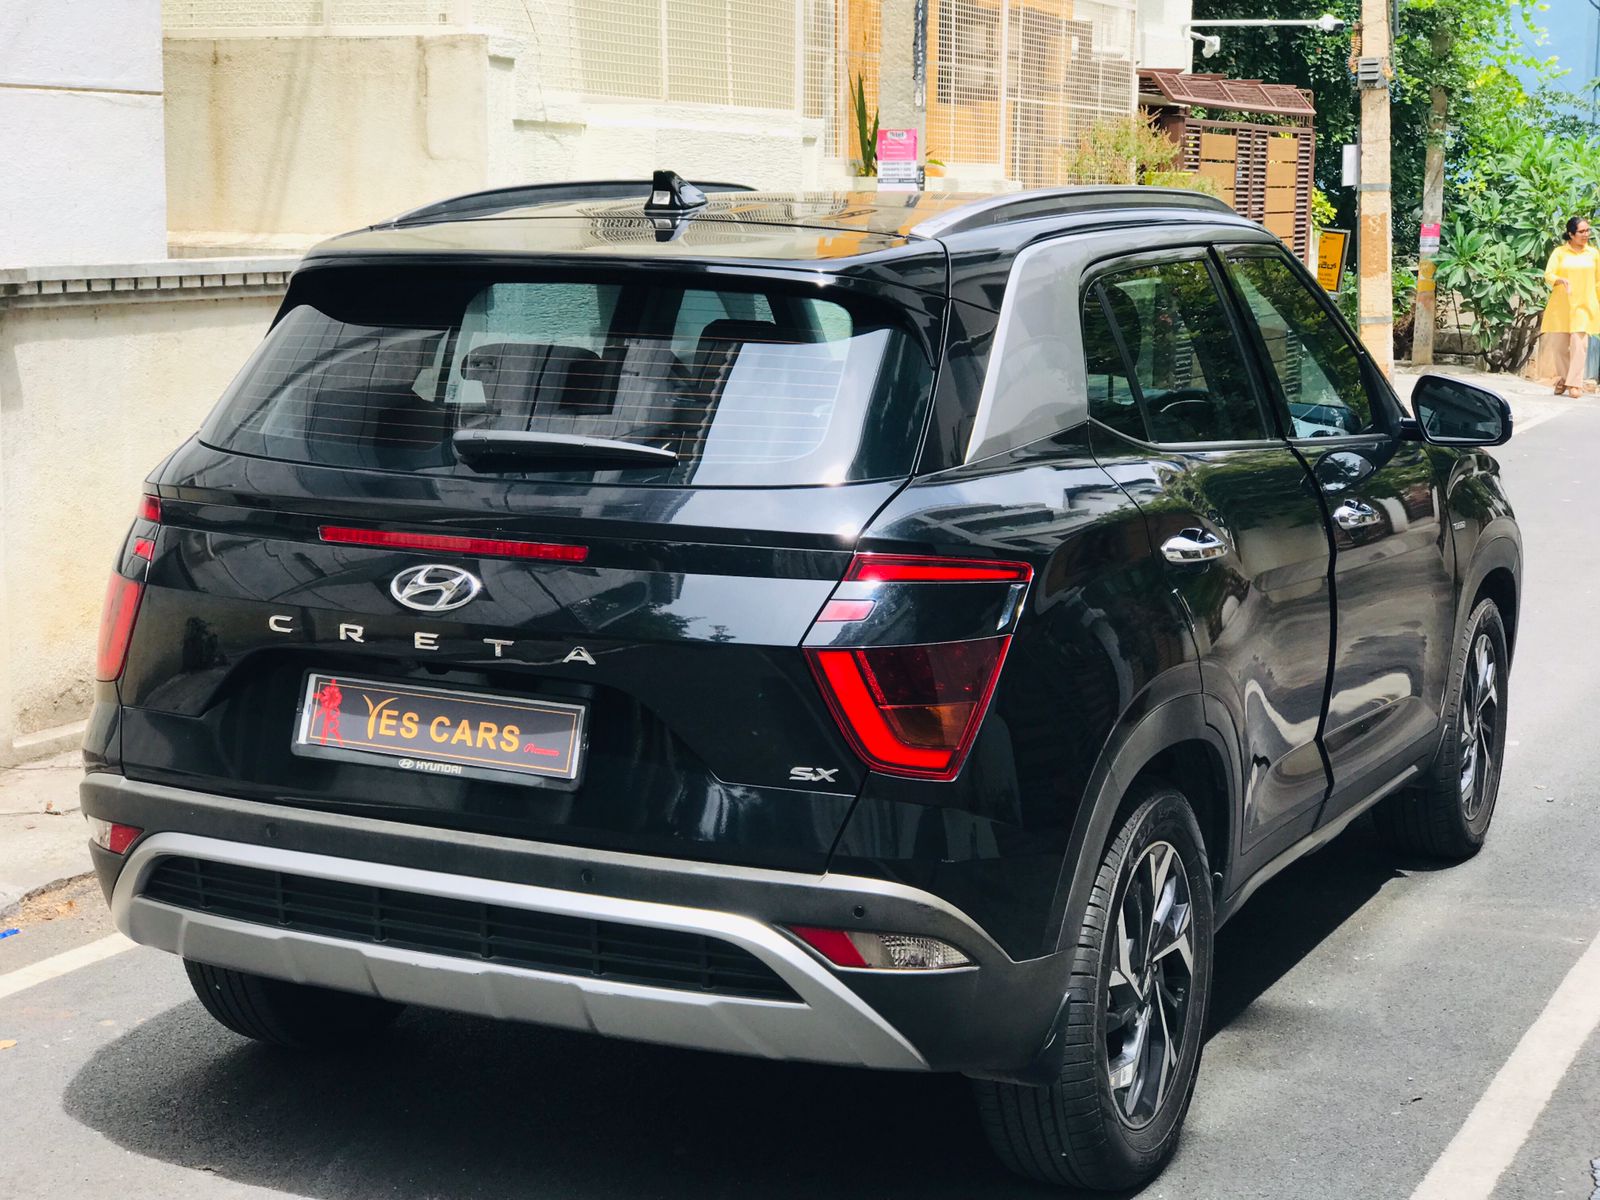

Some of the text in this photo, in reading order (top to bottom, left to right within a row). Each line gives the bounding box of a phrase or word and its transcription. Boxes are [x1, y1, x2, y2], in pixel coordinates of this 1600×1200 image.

[268, 614, 597, 666] CRETA
[362, 694, 521, 753] YES CARS
[416, 760, 463, 775] HYUNDAI
[788, 766, 839, 783] SX
